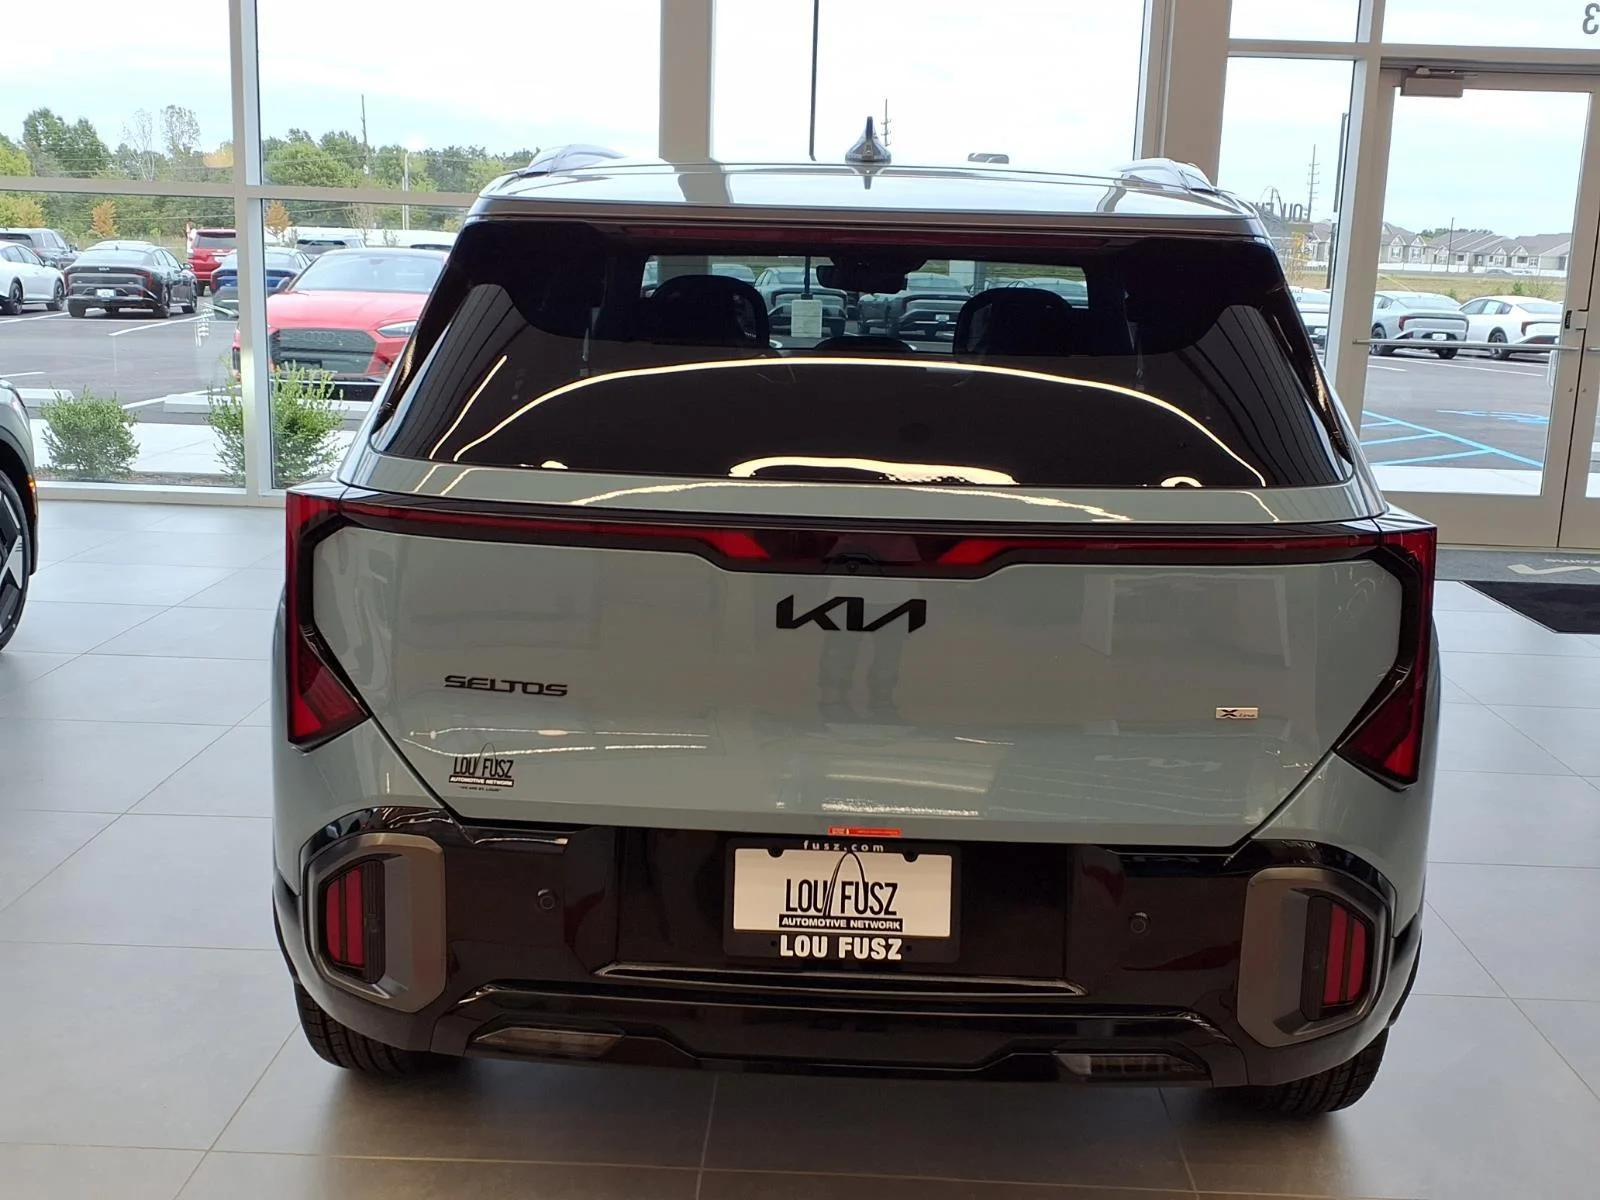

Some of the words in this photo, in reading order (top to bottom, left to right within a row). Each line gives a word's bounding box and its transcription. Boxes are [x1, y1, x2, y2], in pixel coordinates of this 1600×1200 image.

[776, 594, 927, 633] KIA
[444, 675, 568, 697] SELTOS
[453, 756, 478, 775] LOU
[481, 758, 514, 778] FUSZ
[803, 840, 884, 852] fusz.com
[785, 879, 829, 913] LOU
[840, 881, 898, 916] FUSZ
[781, 917, 847, 928] AUTOMOTIVE
[850, 919, 901, 930] NETWORK
[780, 934, 828, 958] LOU
[838, 936, 902, 960] FUSZ
